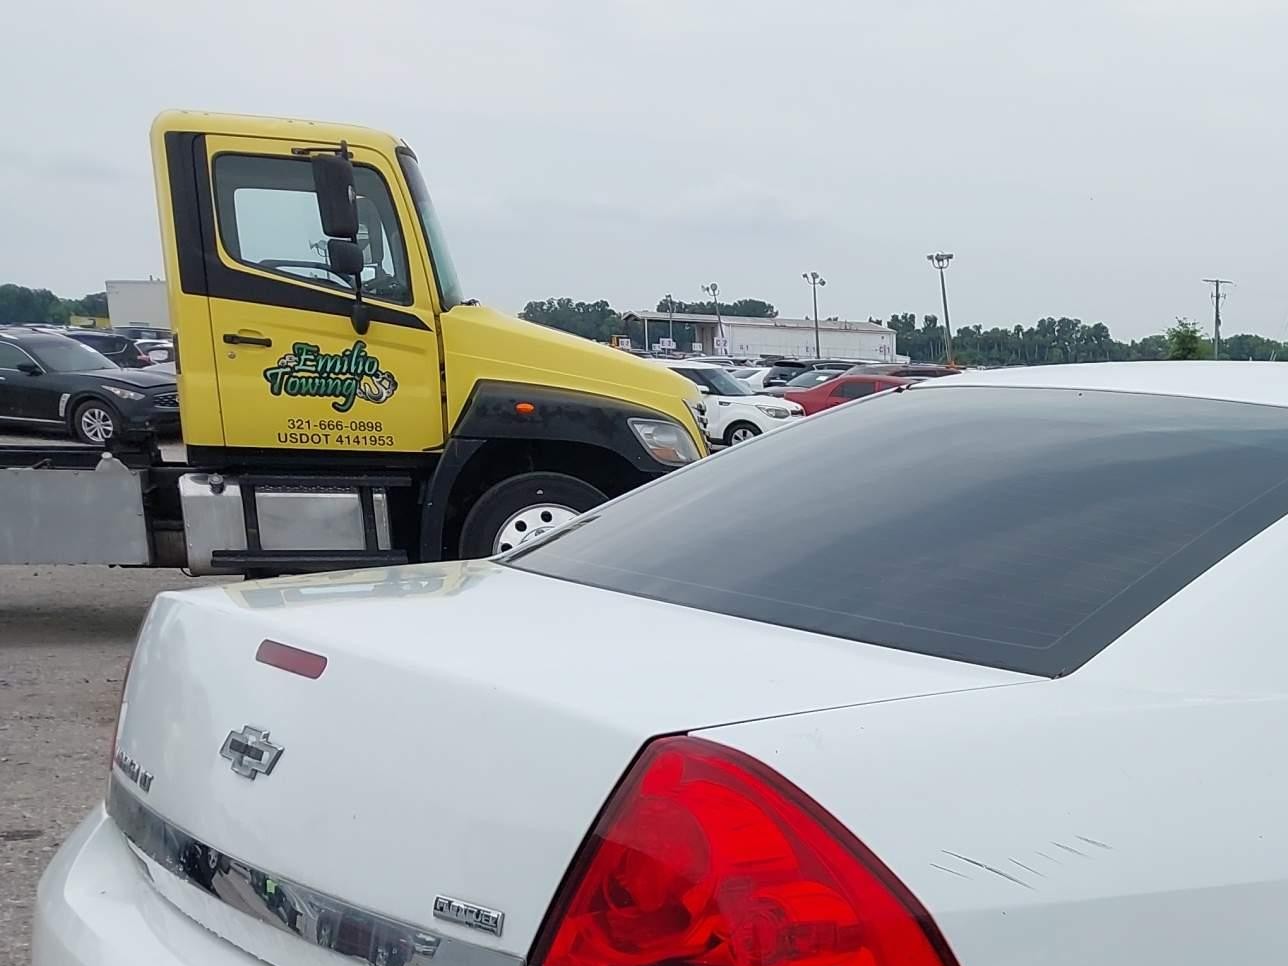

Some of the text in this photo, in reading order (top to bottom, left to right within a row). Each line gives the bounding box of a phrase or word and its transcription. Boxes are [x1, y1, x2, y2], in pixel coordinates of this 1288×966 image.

[292, 340, 379, 376] Emilio
[263, 366, 358, 413] Towing
[287, 418, 383, 433] 321-666-0898
[277, 432, 394, 447] USDOT 4141953
